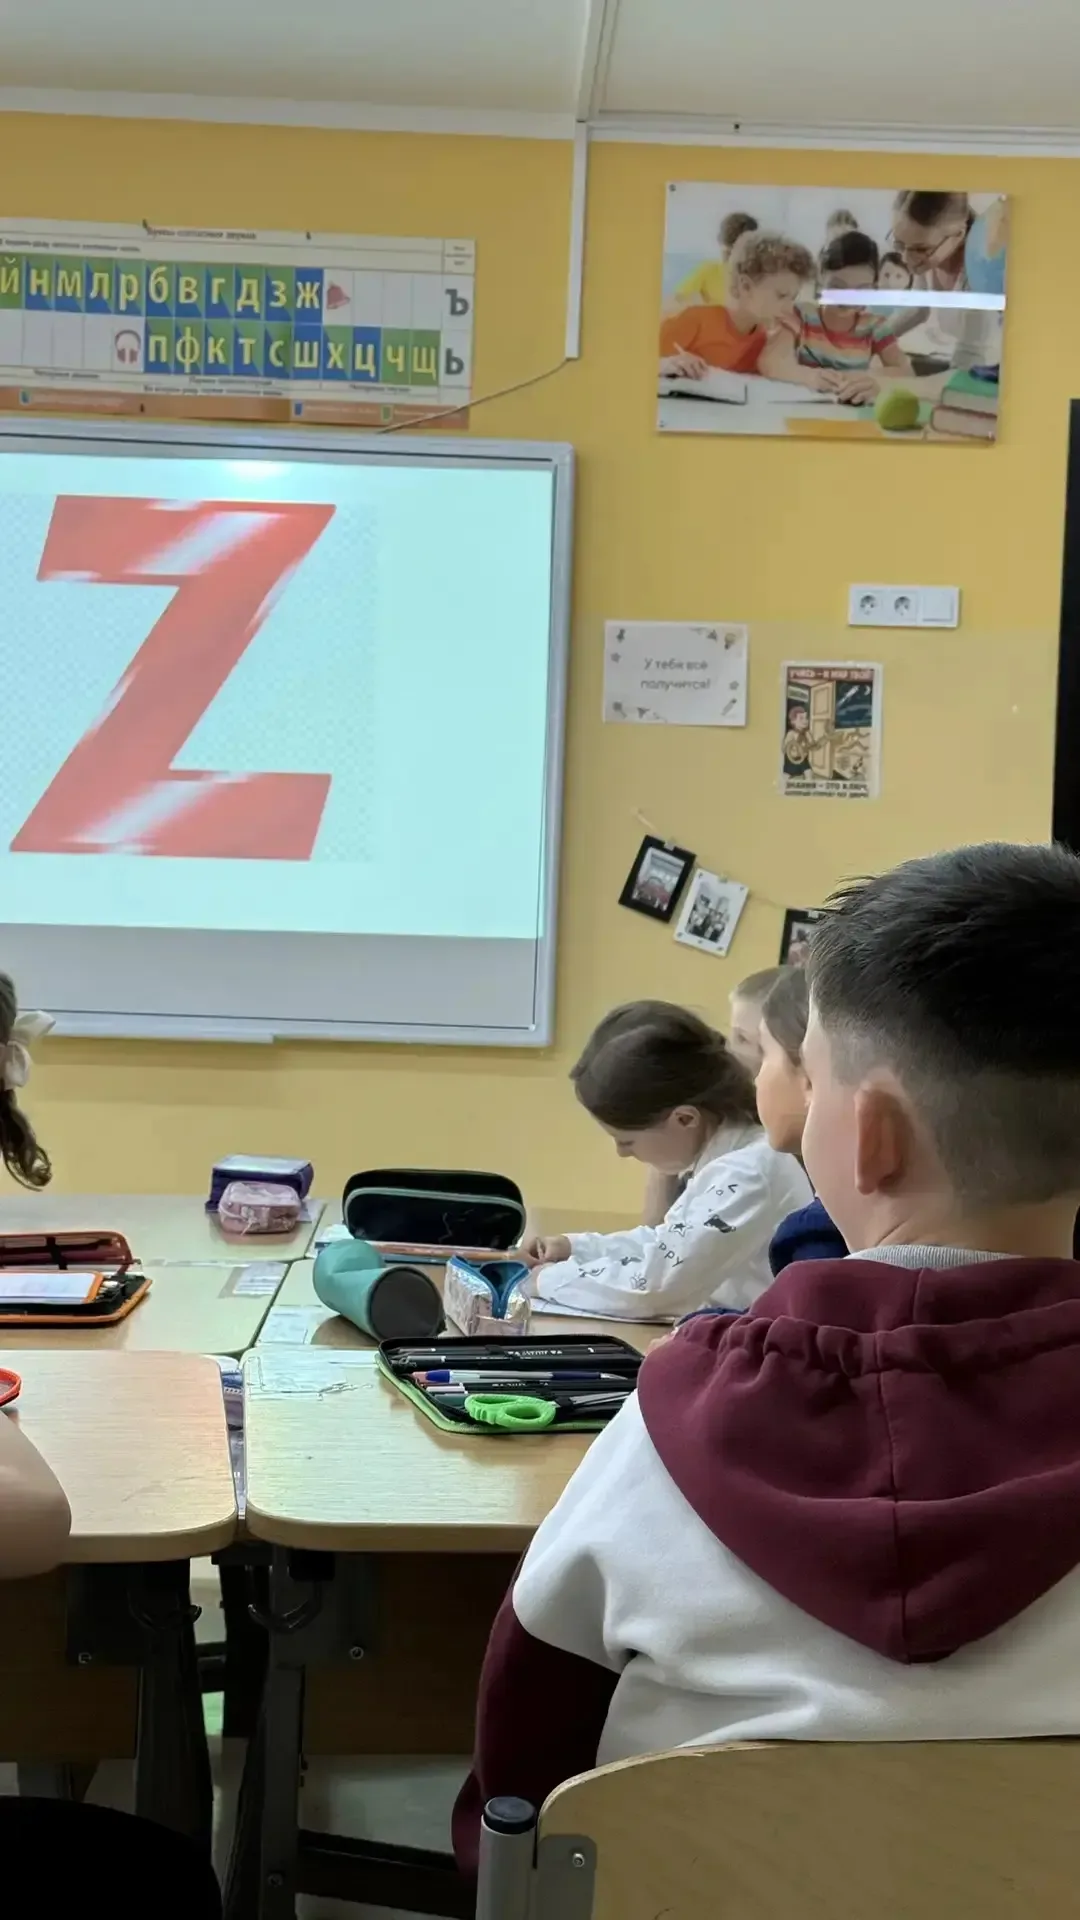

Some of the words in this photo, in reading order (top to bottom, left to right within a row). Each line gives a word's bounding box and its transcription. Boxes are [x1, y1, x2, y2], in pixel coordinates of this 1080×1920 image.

[644, 656, 653, 670] У
[655, 657, 684, 671] тебя
[10, 494, 336, 861] Z
[640, 678, 711, 692] получится!
